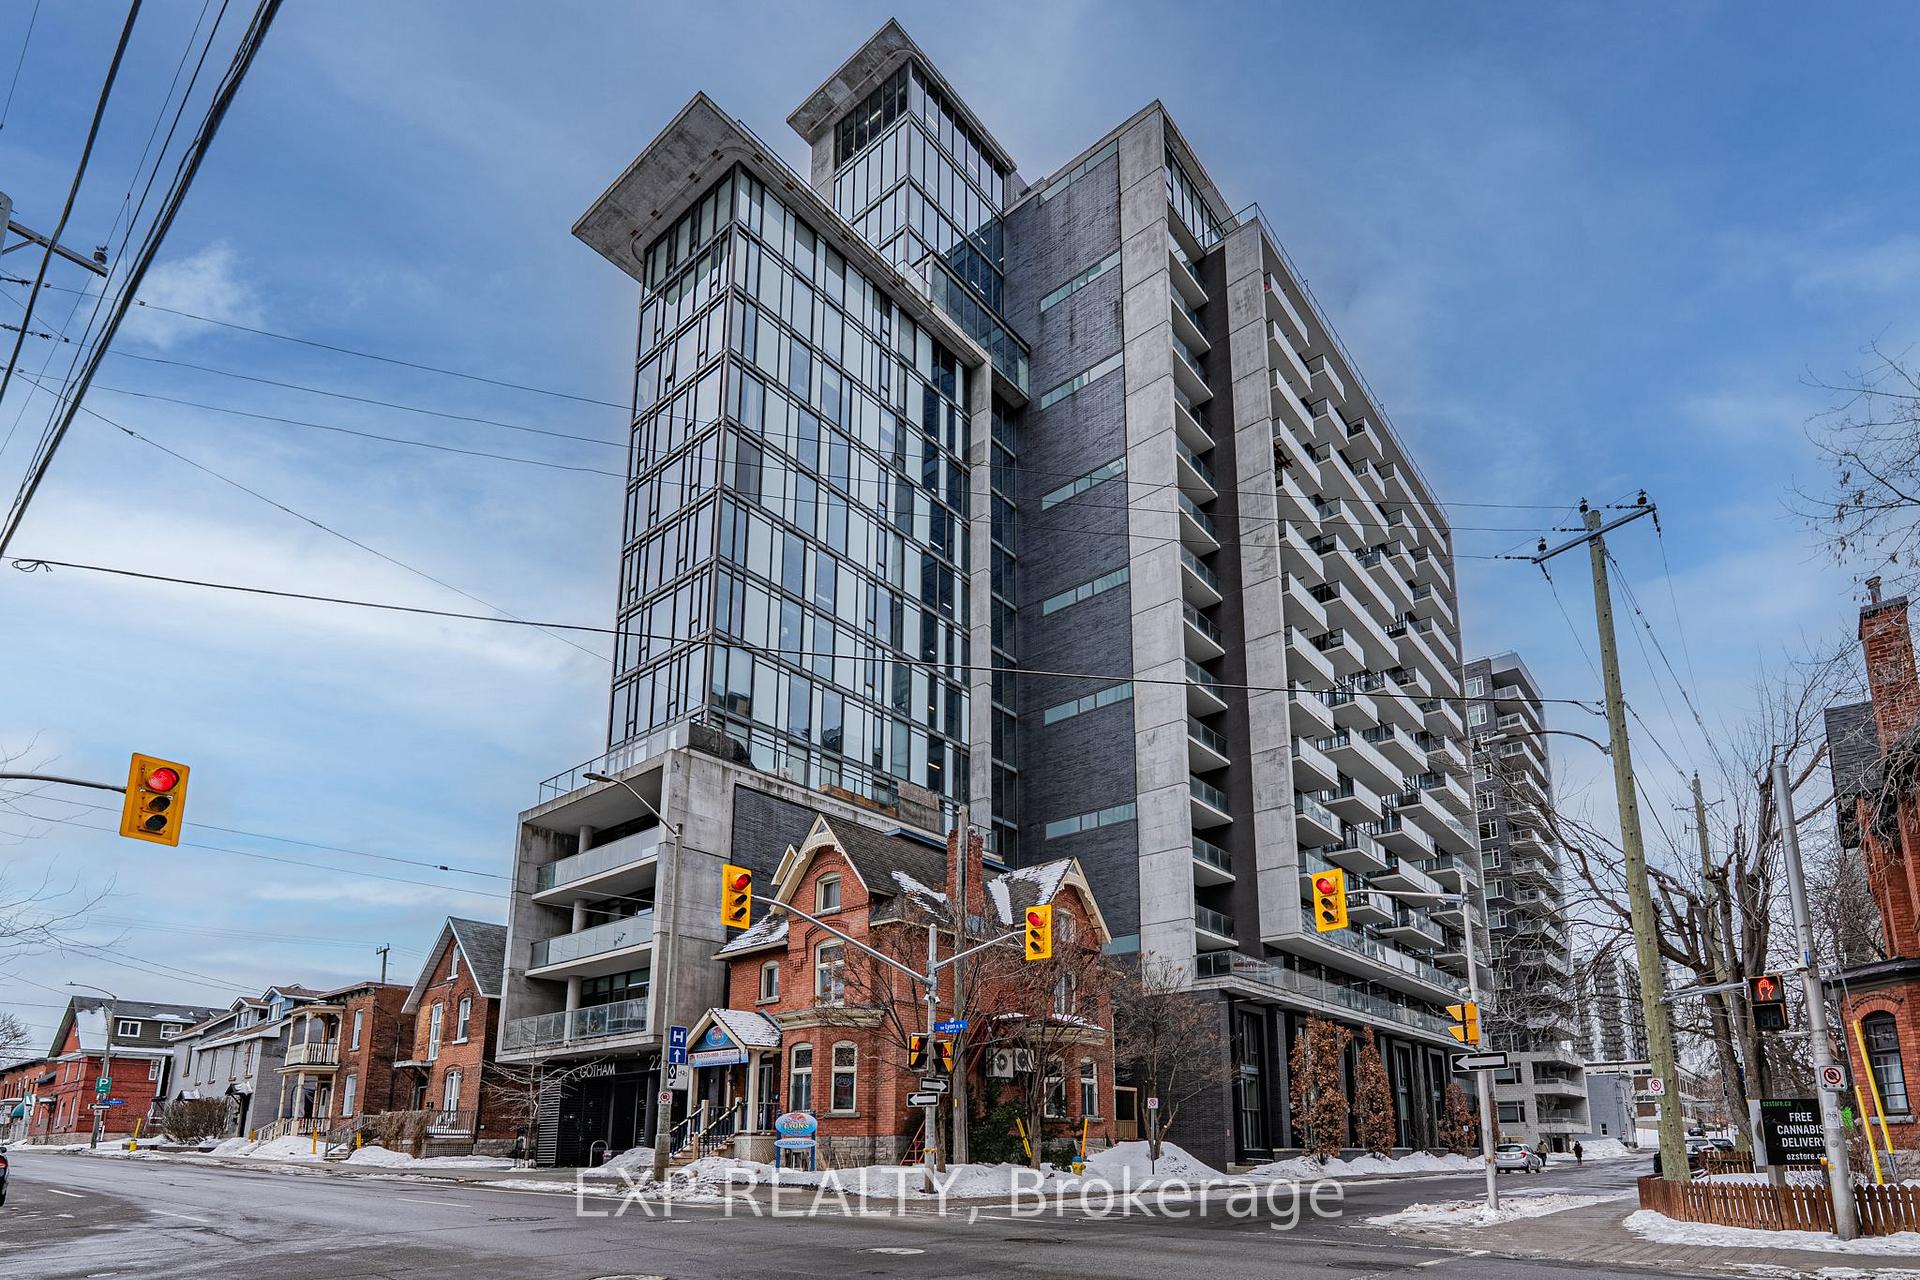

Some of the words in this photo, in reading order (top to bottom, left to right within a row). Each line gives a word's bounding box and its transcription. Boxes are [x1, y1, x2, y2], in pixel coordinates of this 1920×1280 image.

[673, 1030, 684, 1043] H
[580, 1063, 616, 1078] GOTHAM
[99, 1078, 109, 1087] P
[1789, 1112, 1813, 1122] FREE
[1777, 1125, 1824, 1135] CANNABIS
